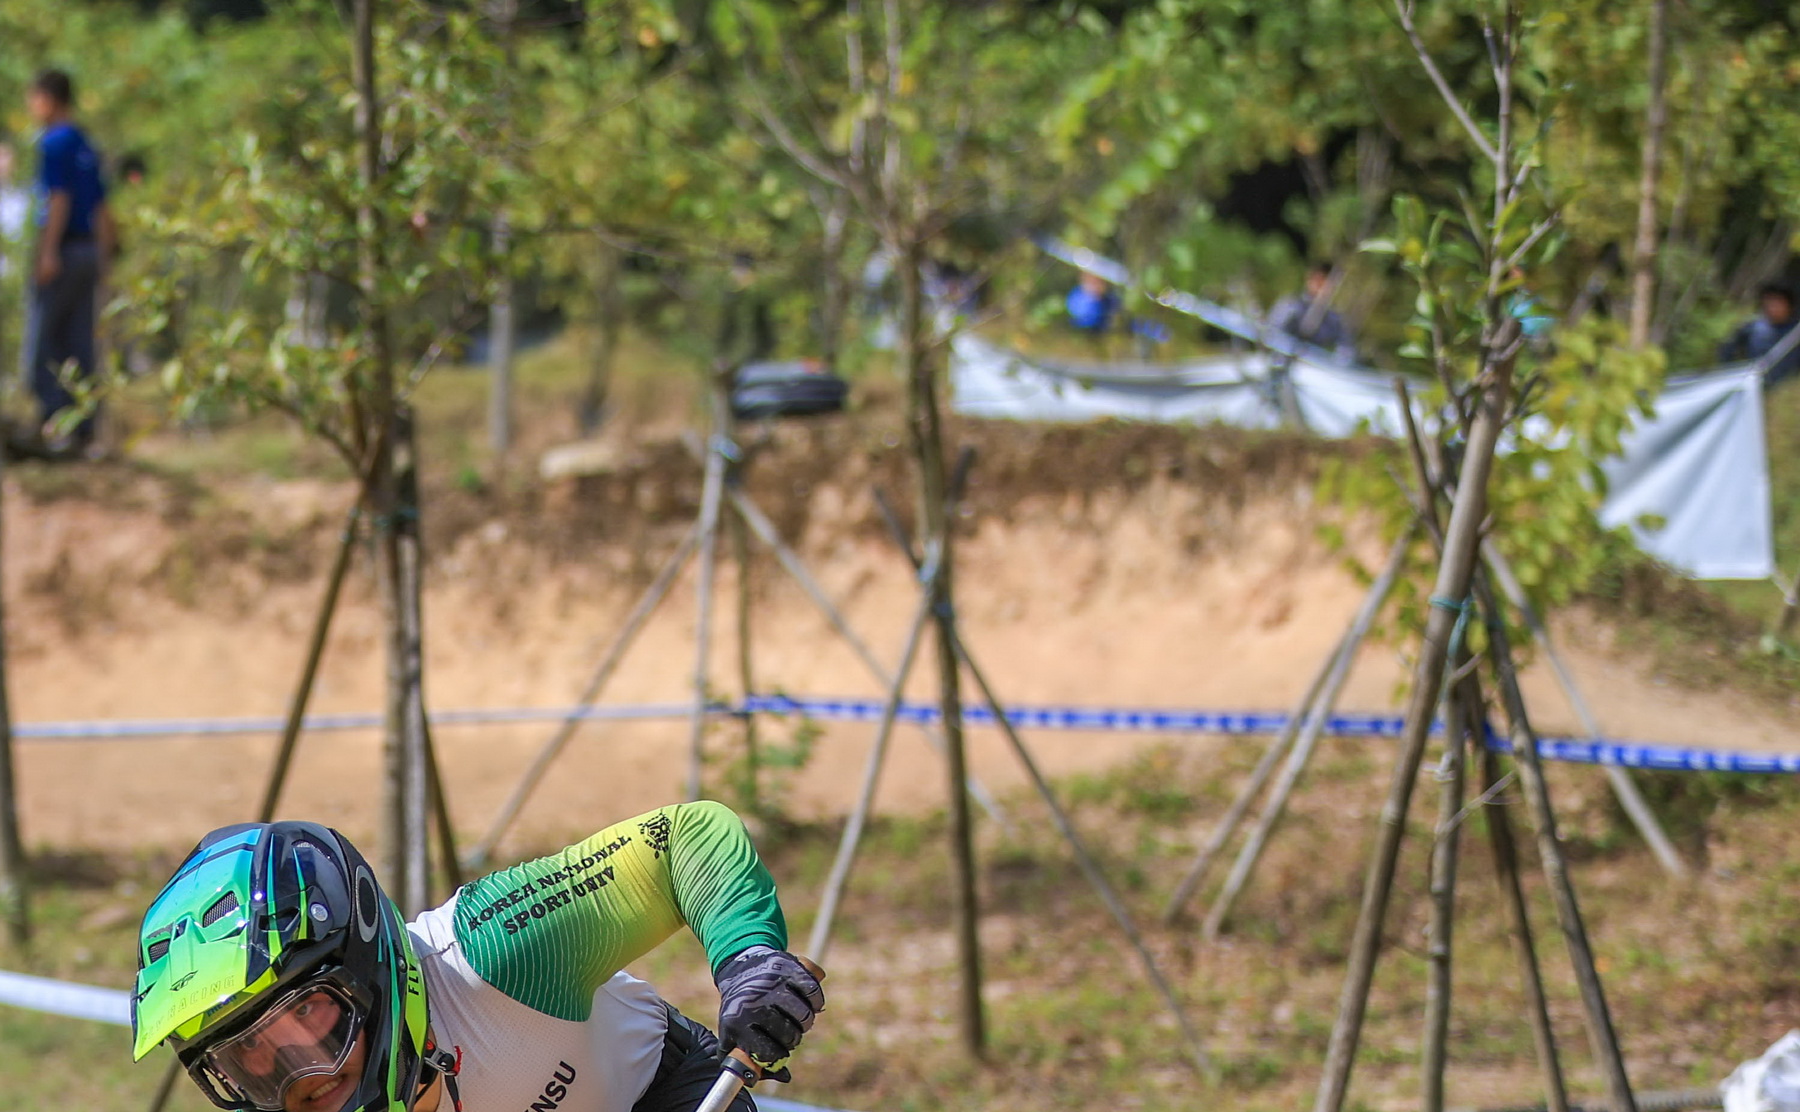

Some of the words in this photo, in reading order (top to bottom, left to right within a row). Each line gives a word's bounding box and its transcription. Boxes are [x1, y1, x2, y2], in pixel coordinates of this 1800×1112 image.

[468, 881, 538, 932] KOREA
[539, 835, 632, 889] NATIONAL
[503, 891, 573, 936] SPORT
[573, 866, 616, 899] UNIV
[167, 975, 236, 1018] RACING
[408, 963, 420, 996] FLY
